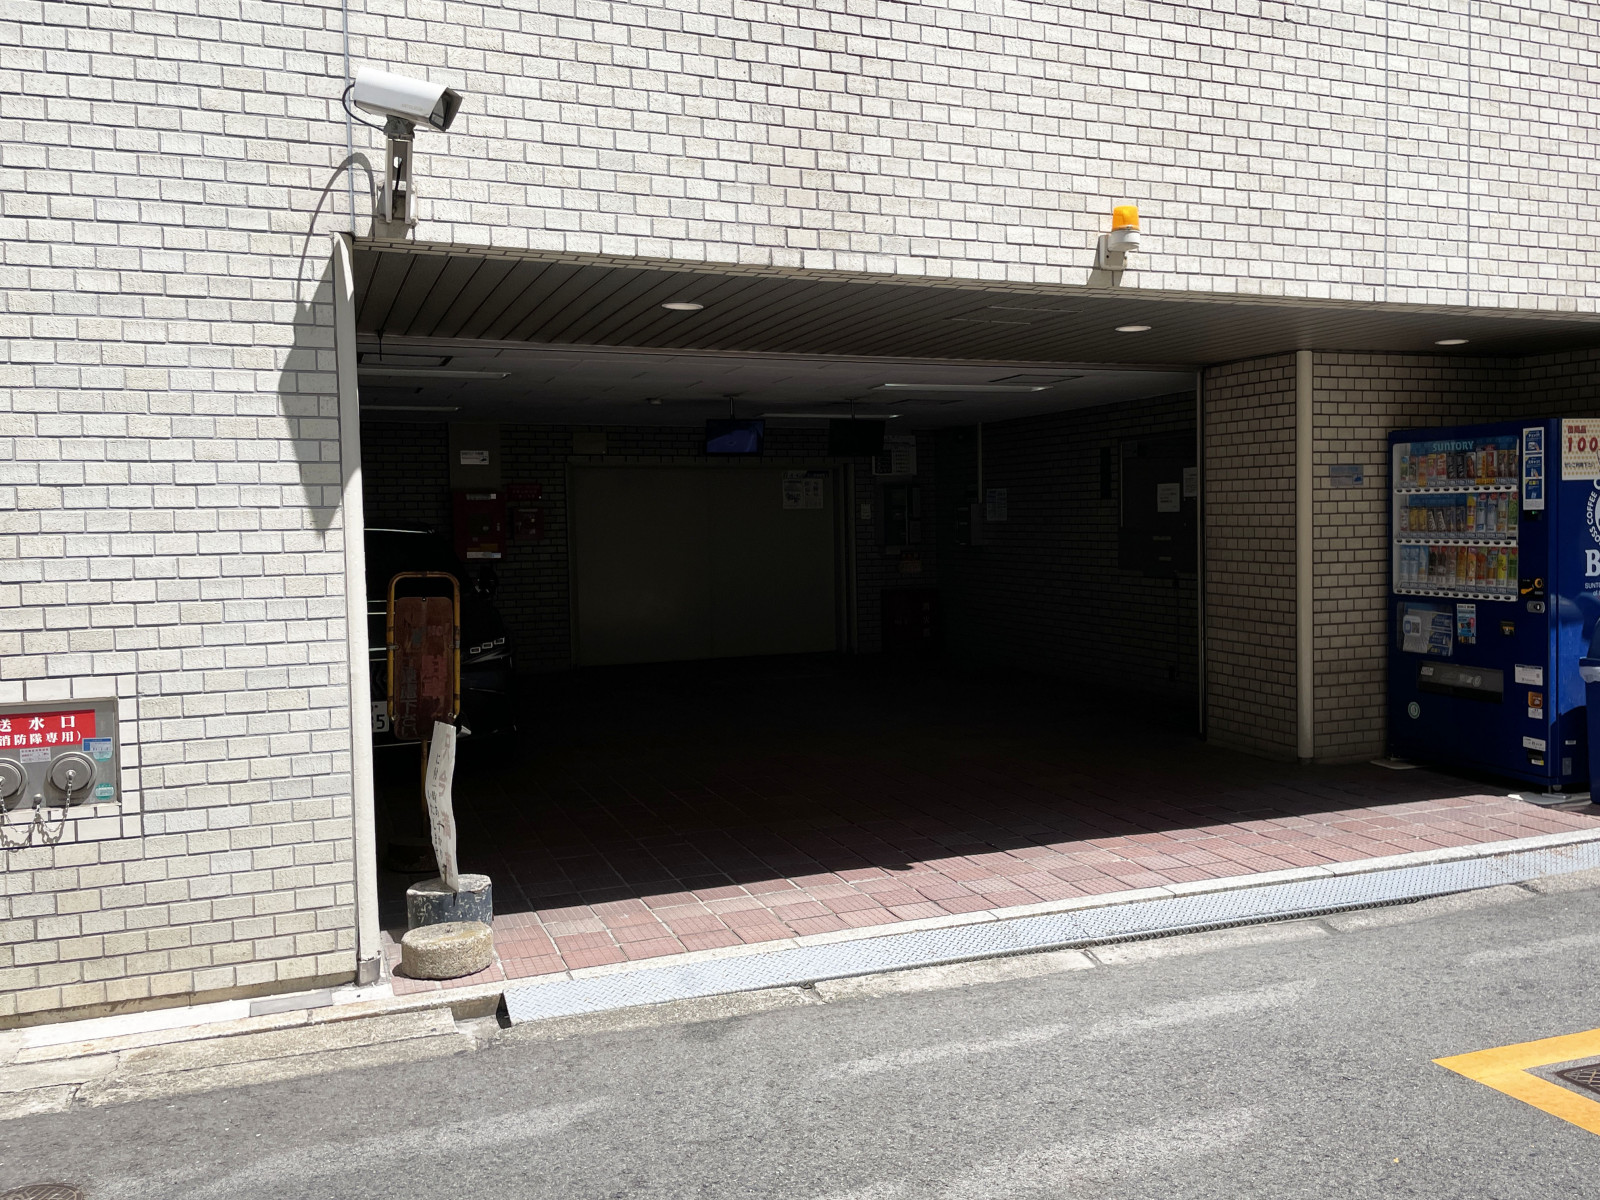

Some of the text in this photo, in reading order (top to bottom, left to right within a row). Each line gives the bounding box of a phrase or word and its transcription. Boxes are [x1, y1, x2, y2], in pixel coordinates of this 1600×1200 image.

[1432, 440, 1475, 452] SUNTORY
[1568, 436, 1598, 452] 100
[1586, 490, 1598, 525] COFFEE
[0, 716, 75, 732] 送水口
